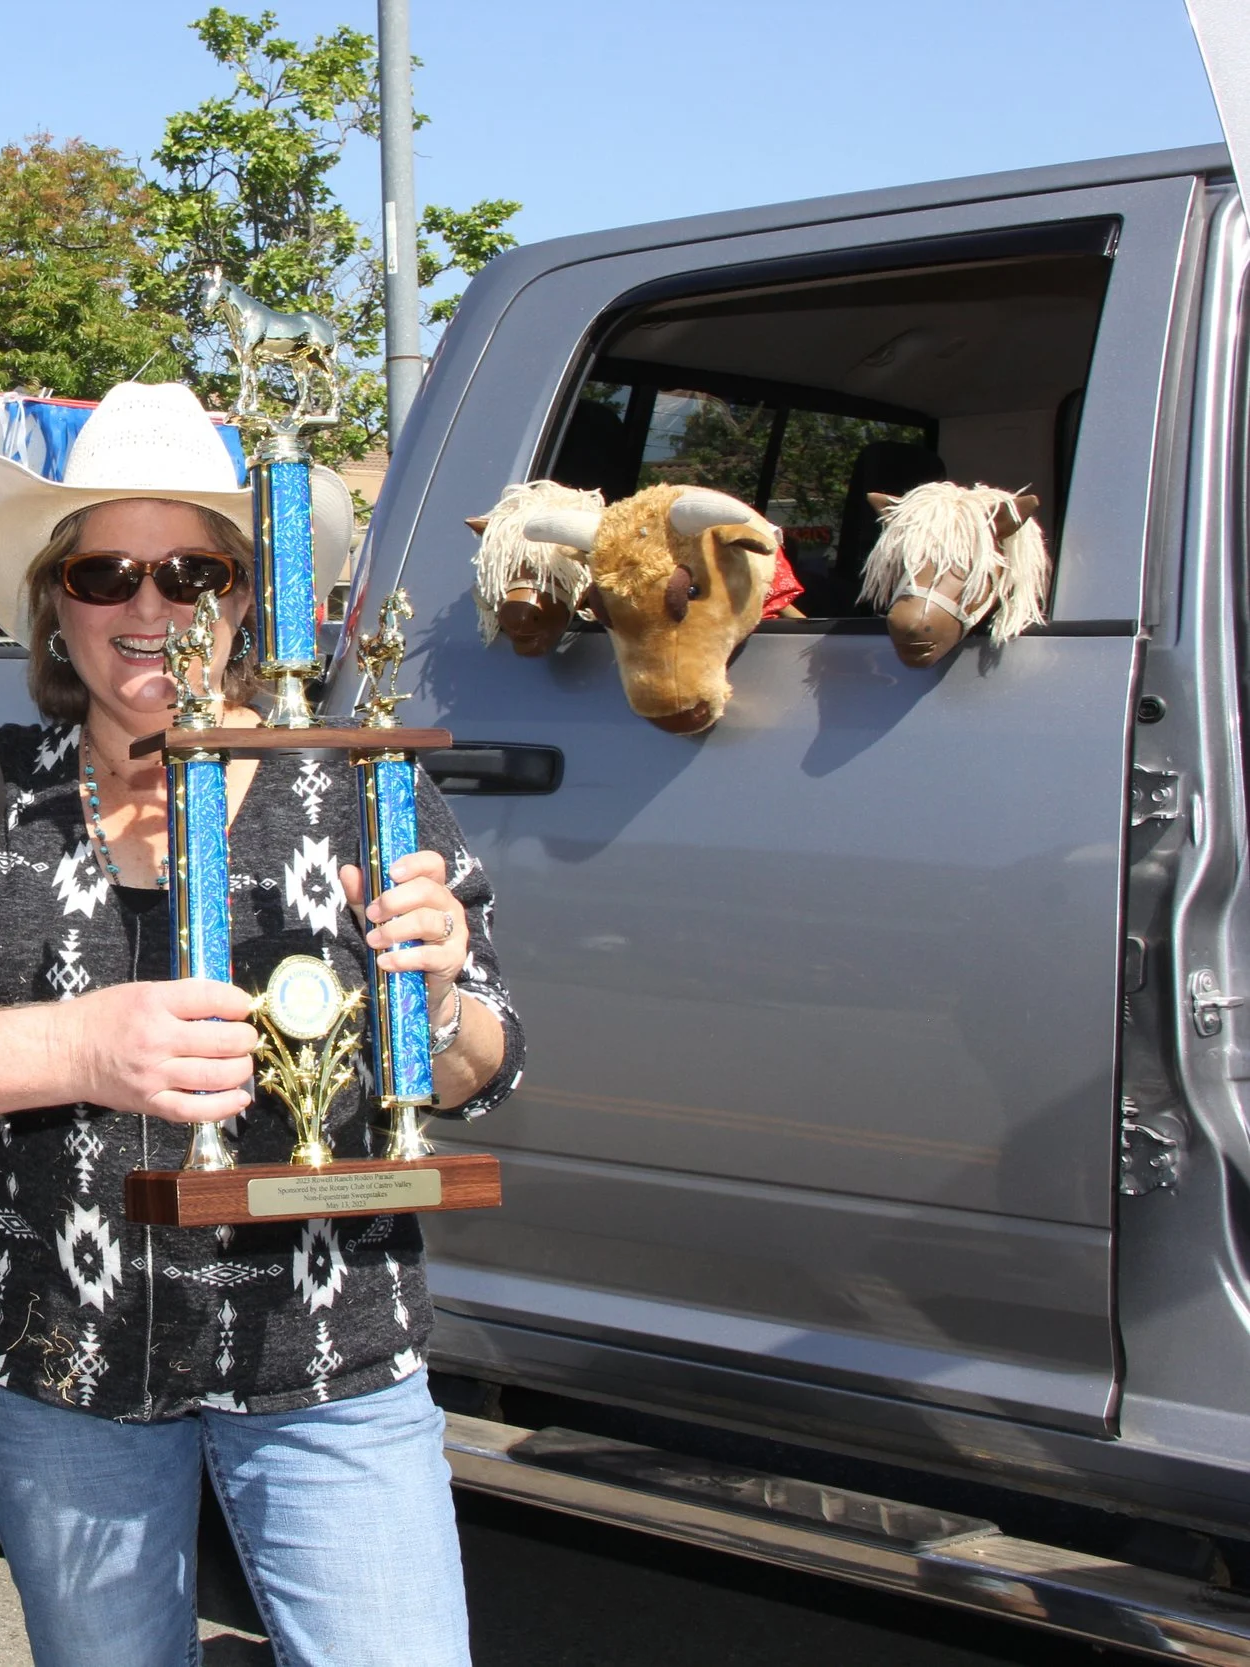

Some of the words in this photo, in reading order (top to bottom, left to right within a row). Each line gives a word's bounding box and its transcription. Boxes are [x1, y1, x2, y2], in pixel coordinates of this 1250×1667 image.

[388, 255, 395, 272] 4
[312, 1176, 333, 1184] Rowell
[354, 1174, 374, 1182] Rodeo
[375, 1173, 395, 1181] Parade
[277, 1186, 308, 1195] Sponsored
[310, 1185, 317, 1195] by
[330, 1183, 349, 1192] Rotary
[395, 1181, 412, 1189] Valley
[303, 1193, 350, 1202] Non-Equestrian
[351, 1191, 388, 1200] Sweepstakes
[352, 1200, 366, 1208] 2023
